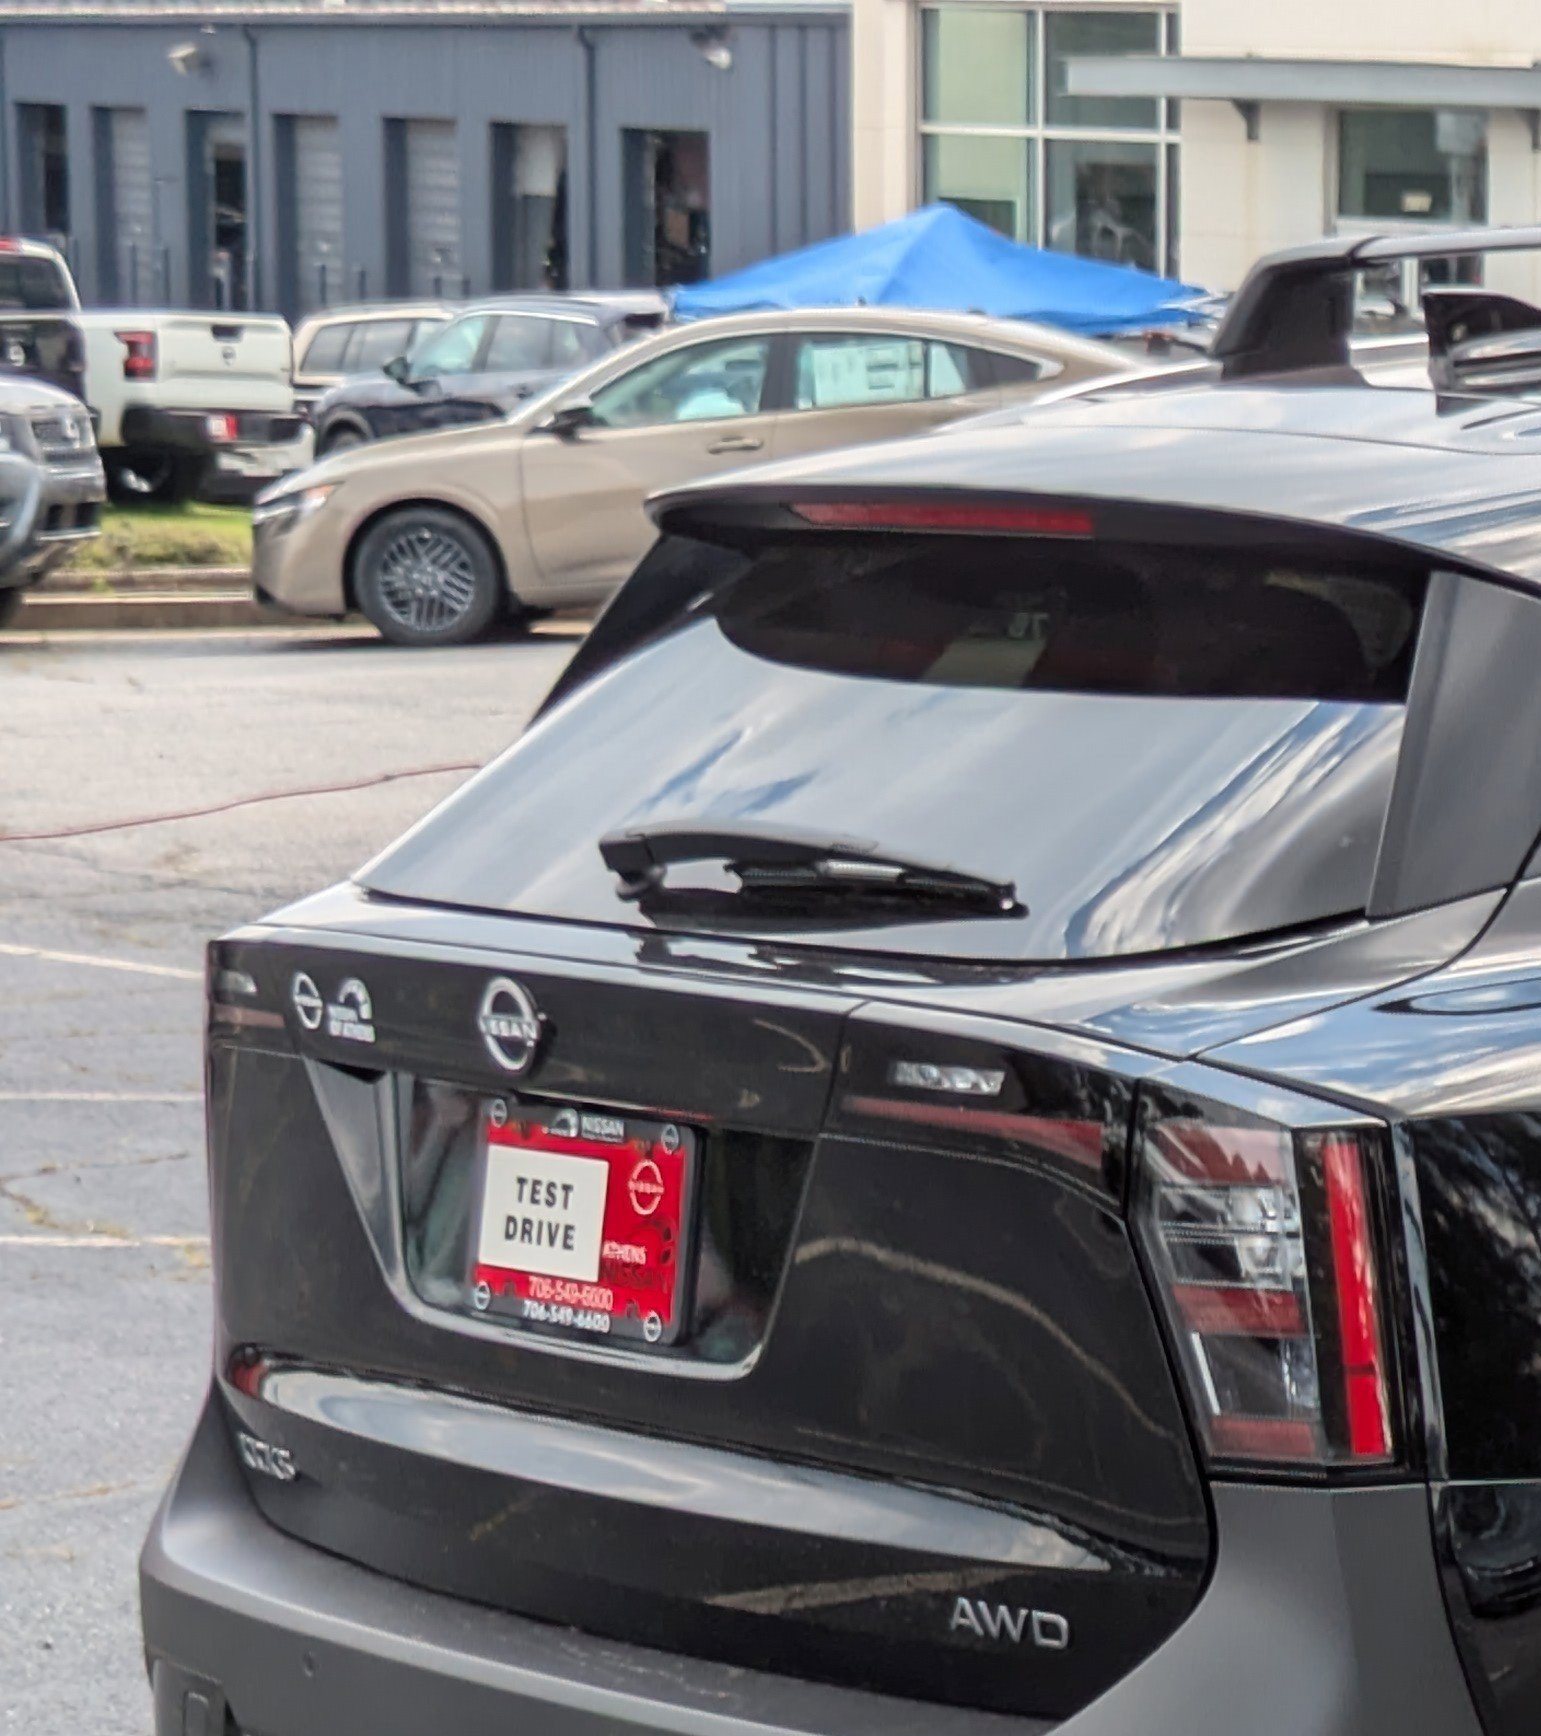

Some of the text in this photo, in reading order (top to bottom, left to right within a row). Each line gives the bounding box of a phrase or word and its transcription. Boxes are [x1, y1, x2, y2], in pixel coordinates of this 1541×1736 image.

[516, 1176, 574, 1210] TEST
[504, 1215, 576, 1251] DRIVE
[950, 1596, 1069, 1649] AWD
